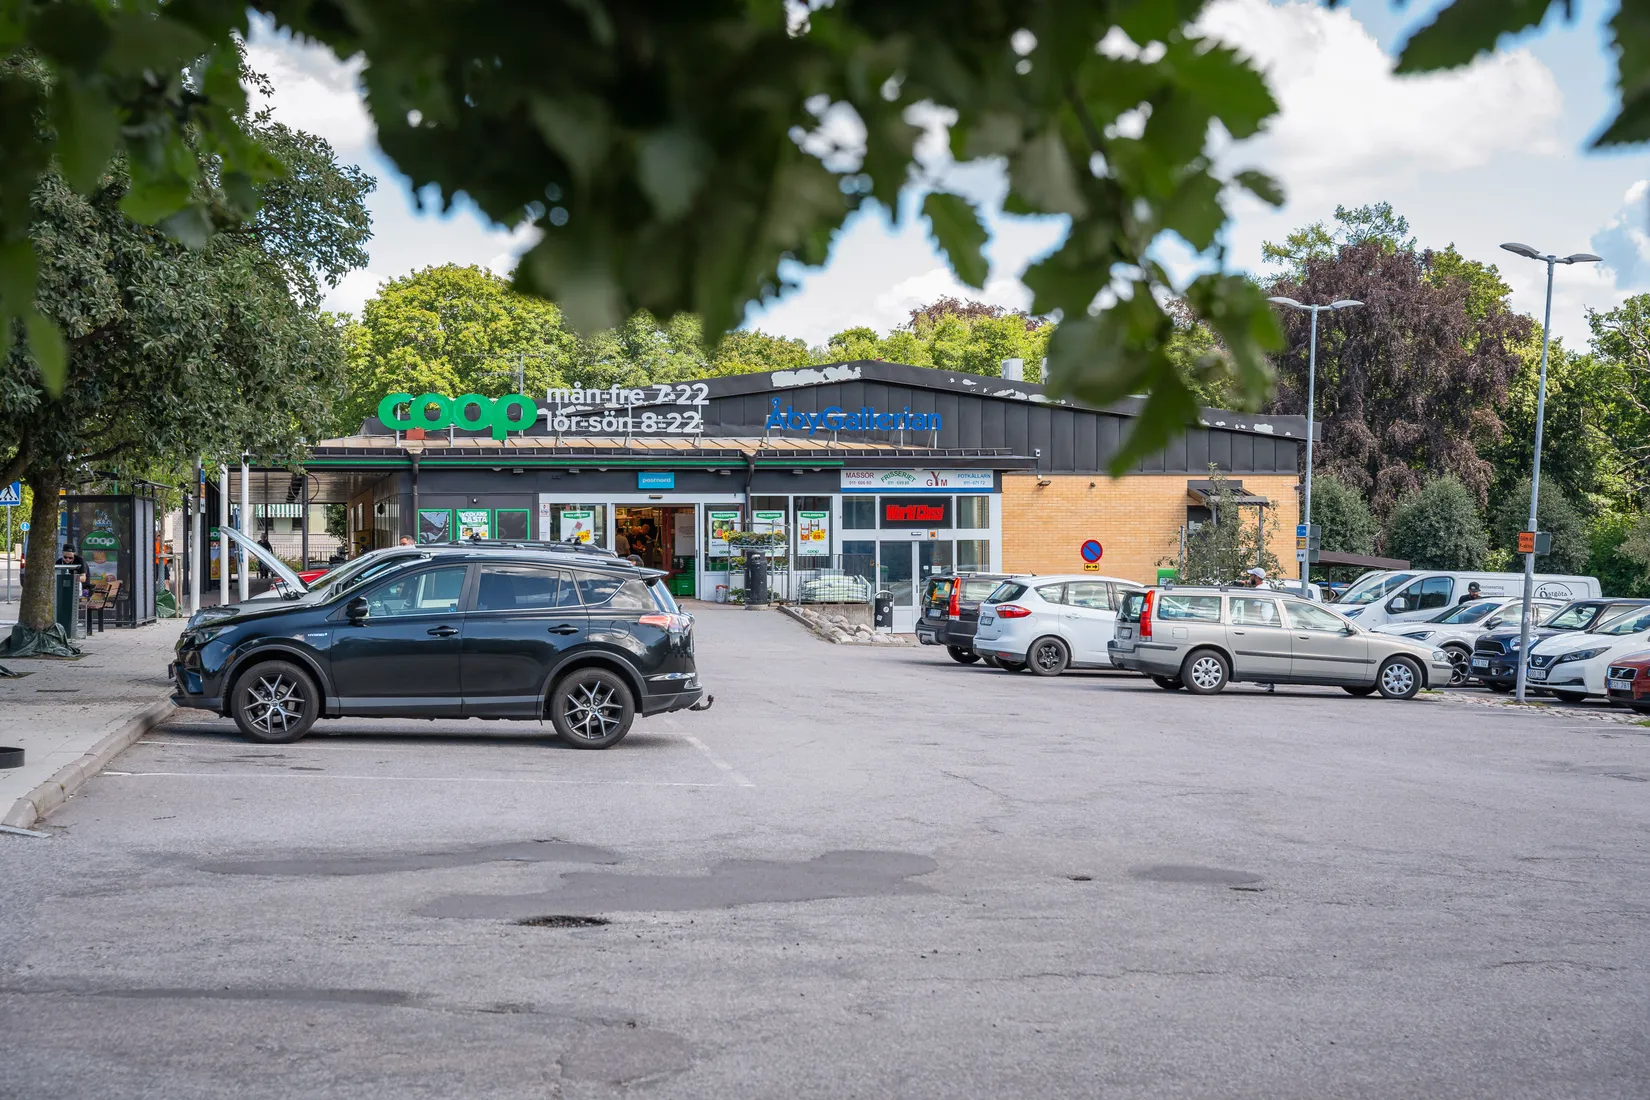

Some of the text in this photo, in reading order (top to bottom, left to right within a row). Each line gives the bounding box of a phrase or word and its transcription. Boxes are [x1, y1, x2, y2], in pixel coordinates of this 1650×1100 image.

[546, 381, 710, 406] mån-fre 7-22
[377, 392, 538, 440] coop
[546, 410, 703, 433] lör-sön 8-22
[766, 397, 942, 435] ÅbyGallerian
[880, 470, 917, 483] FRISSERIET
[926, 470, 948, 487] GYM
[85, 536, 116, 547] coop
[1539, 587, 1568, 598] Östgöta
